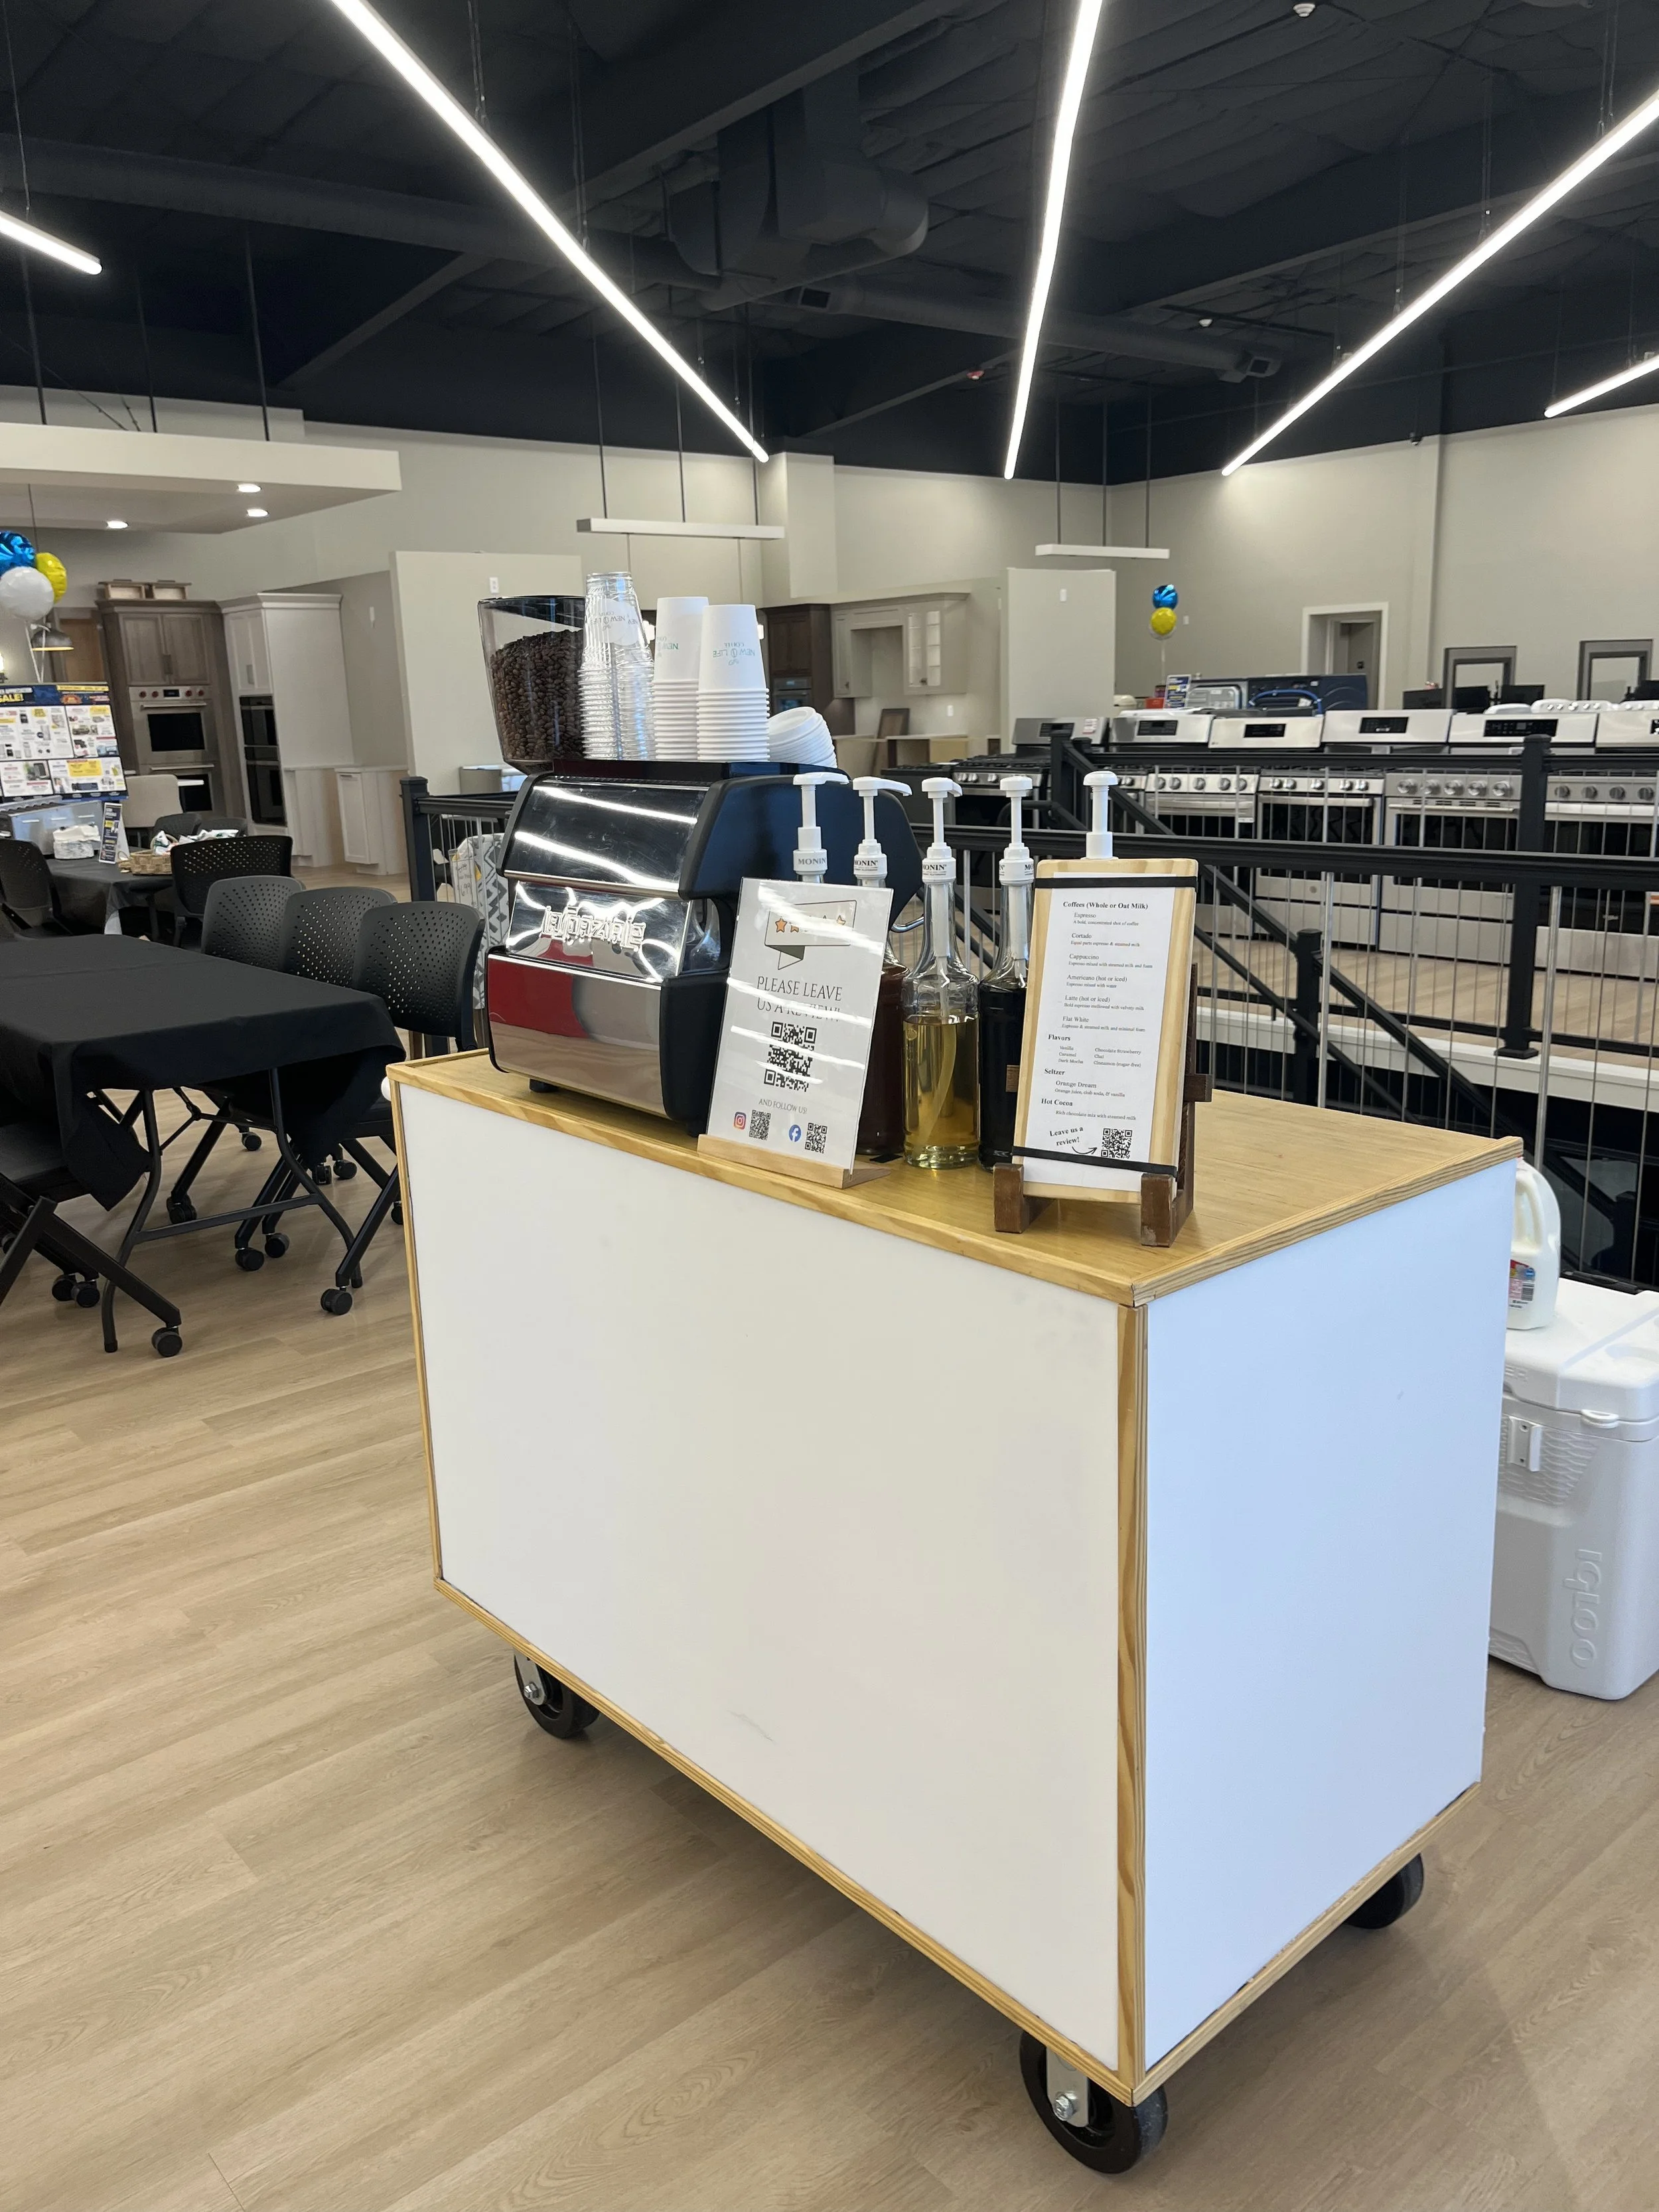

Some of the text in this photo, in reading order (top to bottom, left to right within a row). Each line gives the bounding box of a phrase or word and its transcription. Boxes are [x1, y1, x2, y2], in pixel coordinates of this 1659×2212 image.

[757, 976, 842, 1001] PLEASE LEAVE
[757, 997, 771, 1011] US
[773, 1101, 797, 1112] FOLLOW
[1056, 1137, 1080, 1145] review!
[1563, 1549, 1602, 1669] IGLOO
